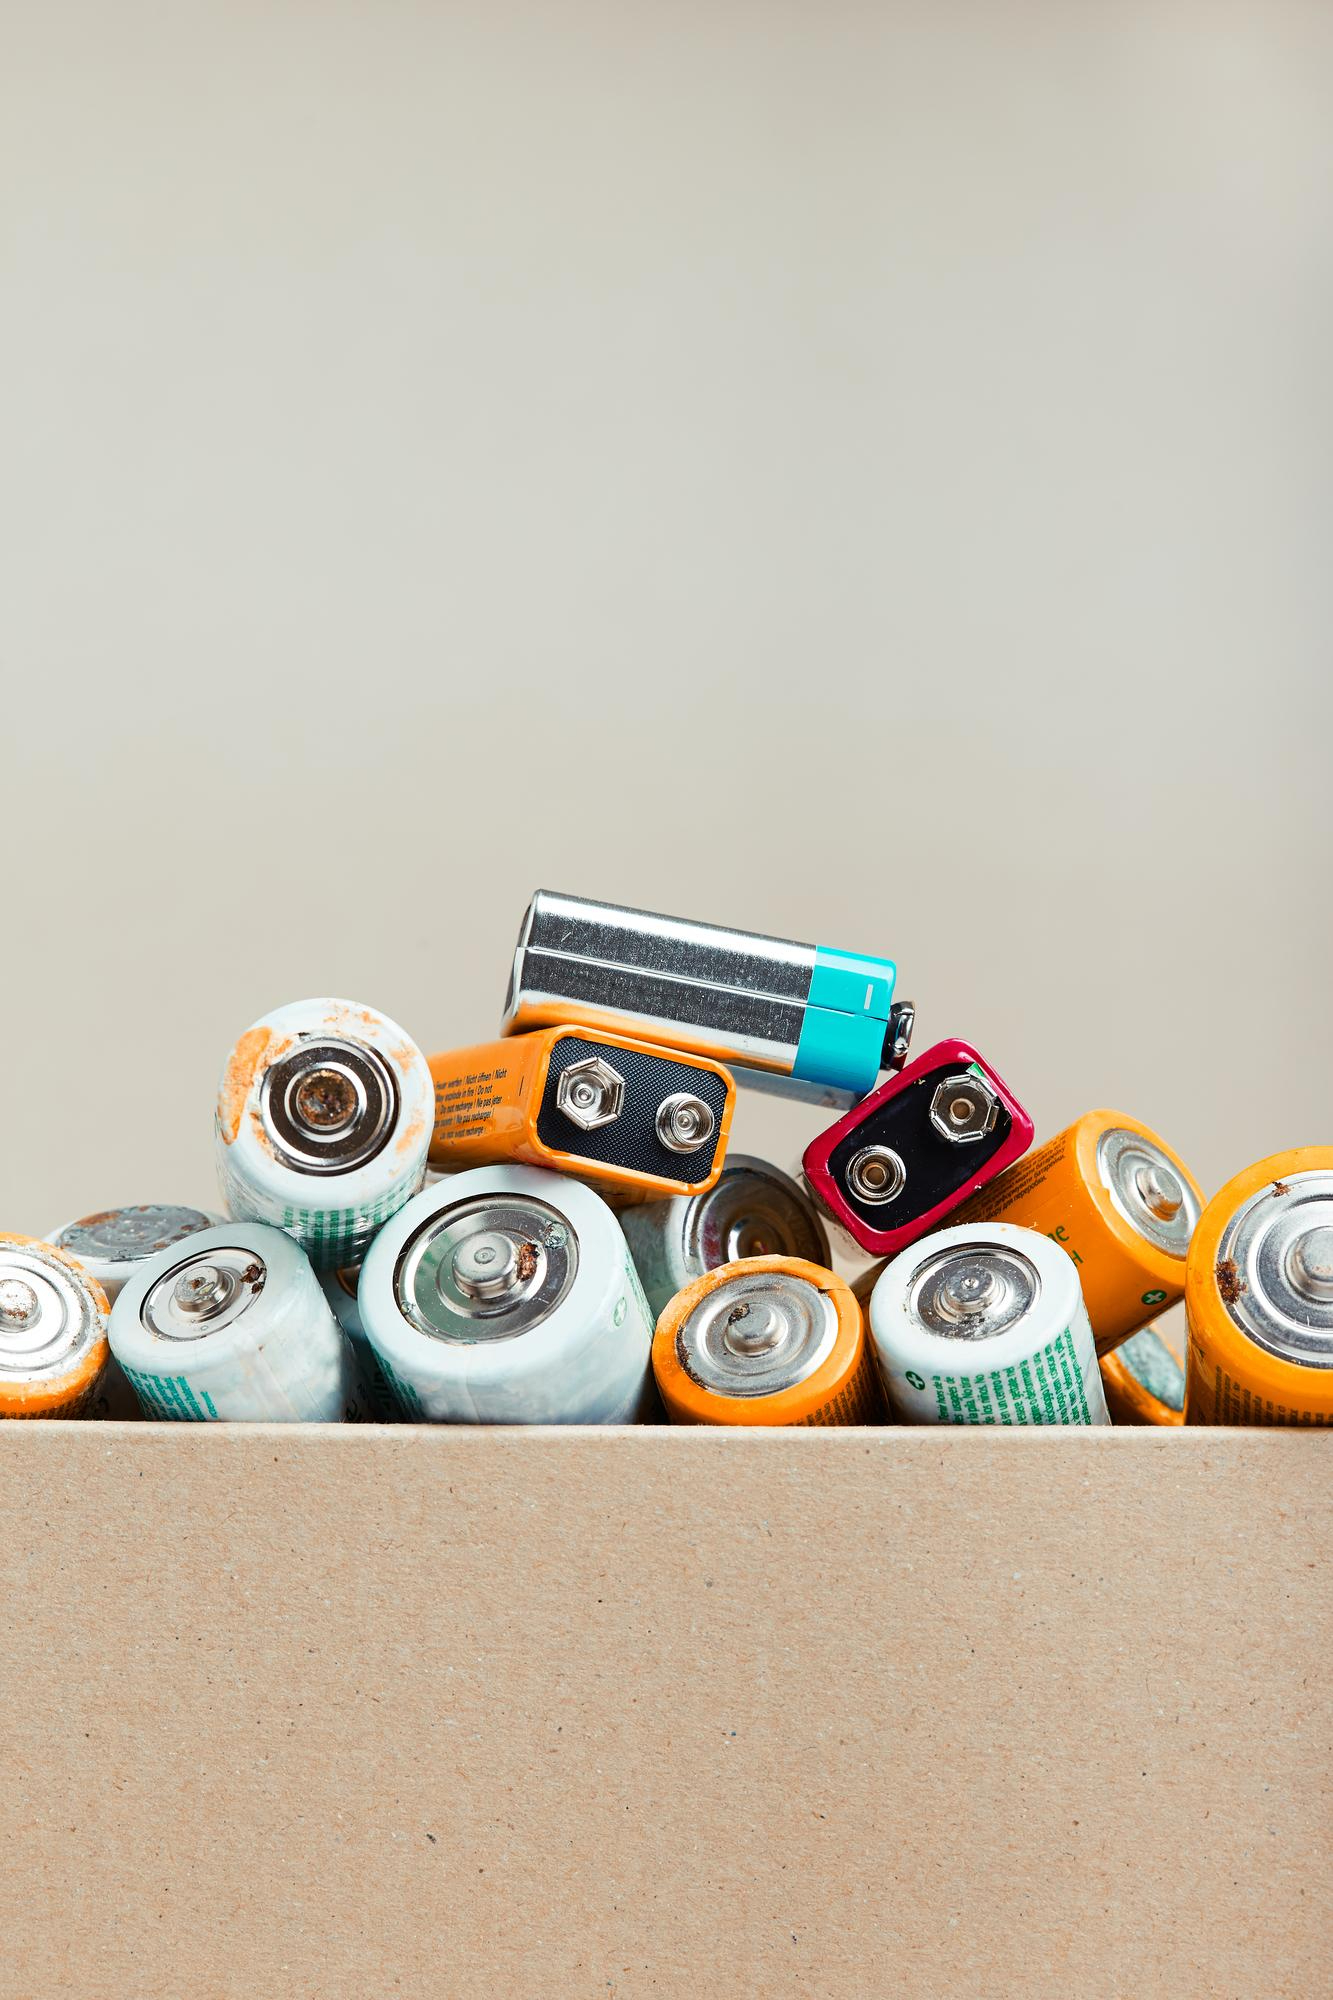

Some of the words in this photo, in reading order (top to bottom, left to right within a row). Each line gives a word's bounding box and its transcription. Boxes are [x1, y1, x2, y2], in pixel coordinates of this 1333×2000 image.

[496, 1068, 507, 1078] Nicht
[974, 1374, 984, 1384] No
[988, 1370, 1000, 1380] de
[962, 1388, 972, 1399] No
[992, 1379, 1004, 1400] centro
[982, 1404, 992, 1415] los
